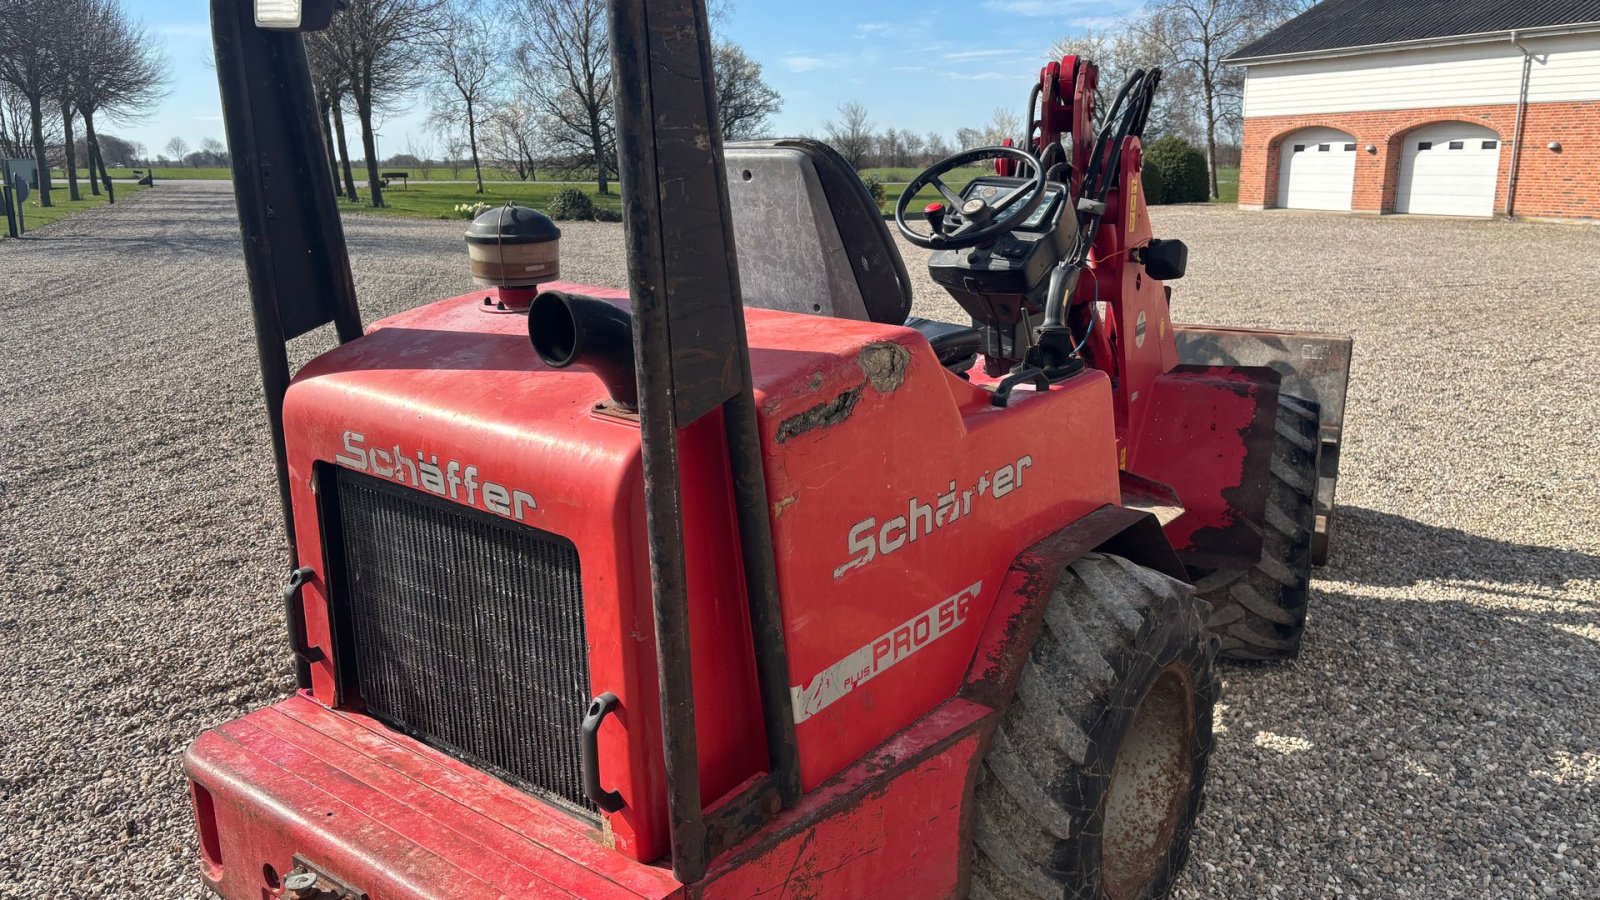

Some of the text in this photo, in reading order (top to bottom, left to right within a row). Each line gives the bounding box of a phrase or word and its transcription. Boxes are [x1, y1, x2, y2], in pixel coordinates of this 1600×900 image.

[335, 430, 538, 520] Schäffer
[843, 666, 871, 690] PLUS
[872, 614, 930, 672] PRO
